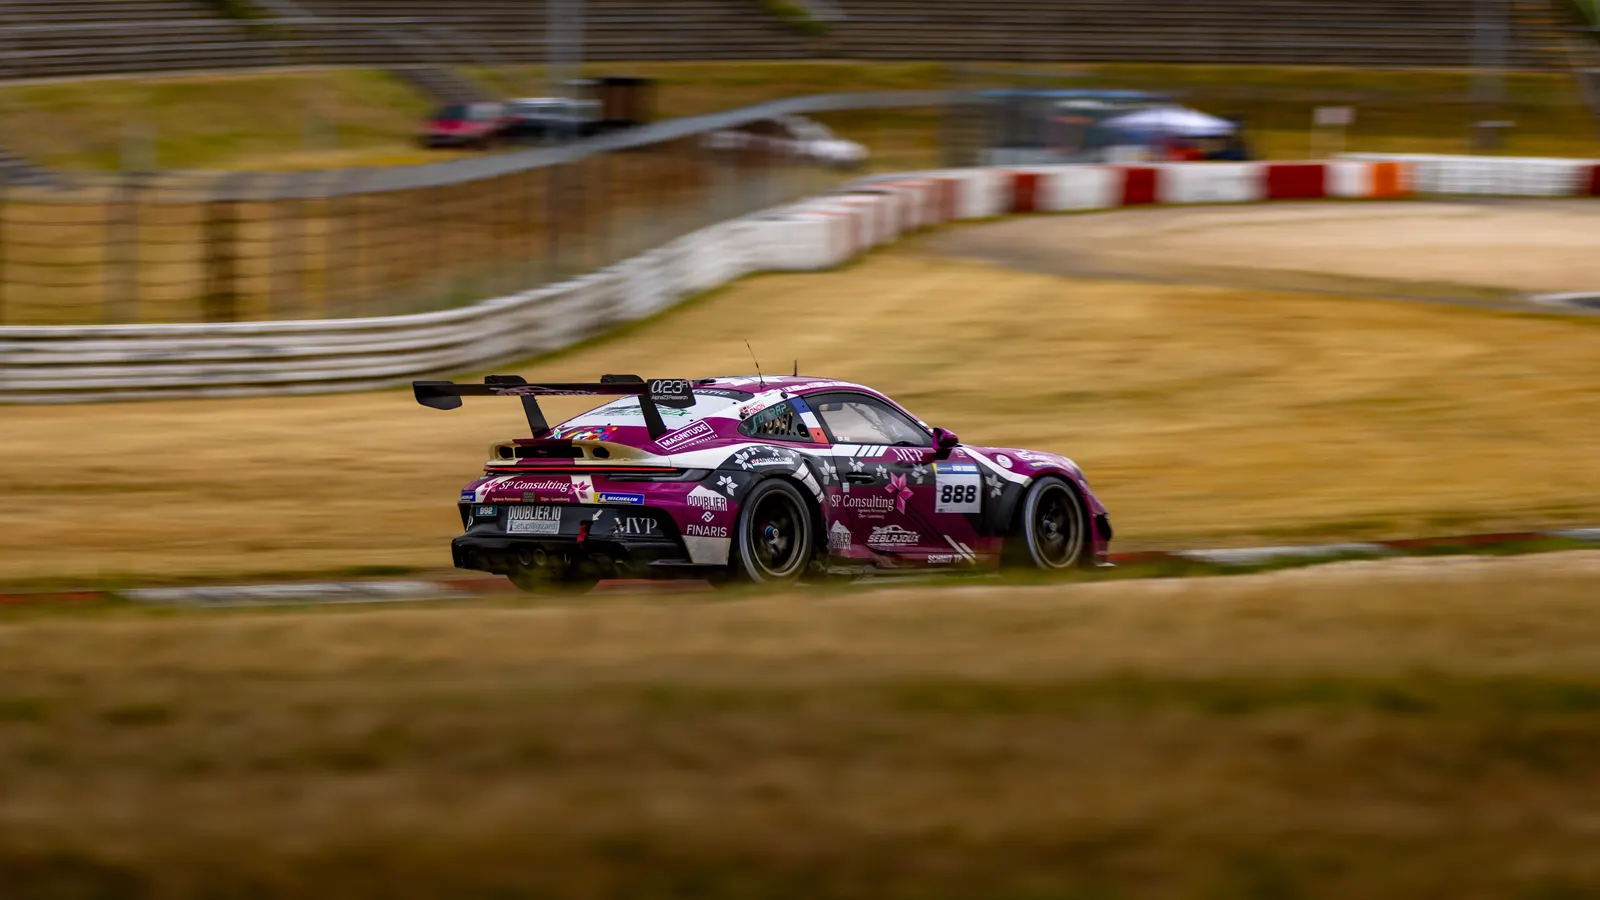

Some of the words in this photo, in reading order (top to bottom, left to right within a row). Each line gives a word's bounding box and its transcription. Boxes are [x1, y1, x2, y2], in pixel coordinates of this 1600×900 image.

[662, 424, 708, 446] MAGNITUDE
[892, 448, 923, 461] MVP
[499, 481, 514, 490] SP
[515, 480, 570, 493] Consulting
[941, 485, 977, 503] 888
[687, 495, 726, 510] DOUBLIER
[831, 494, 842, 508] SP
[843, 494, 895, 511] Consulting
[508, 506, 562, 521] DOUBLIER.IO
[612, 517, 658, 534] MVP
[686, 524, 728, 538] FINARIS
